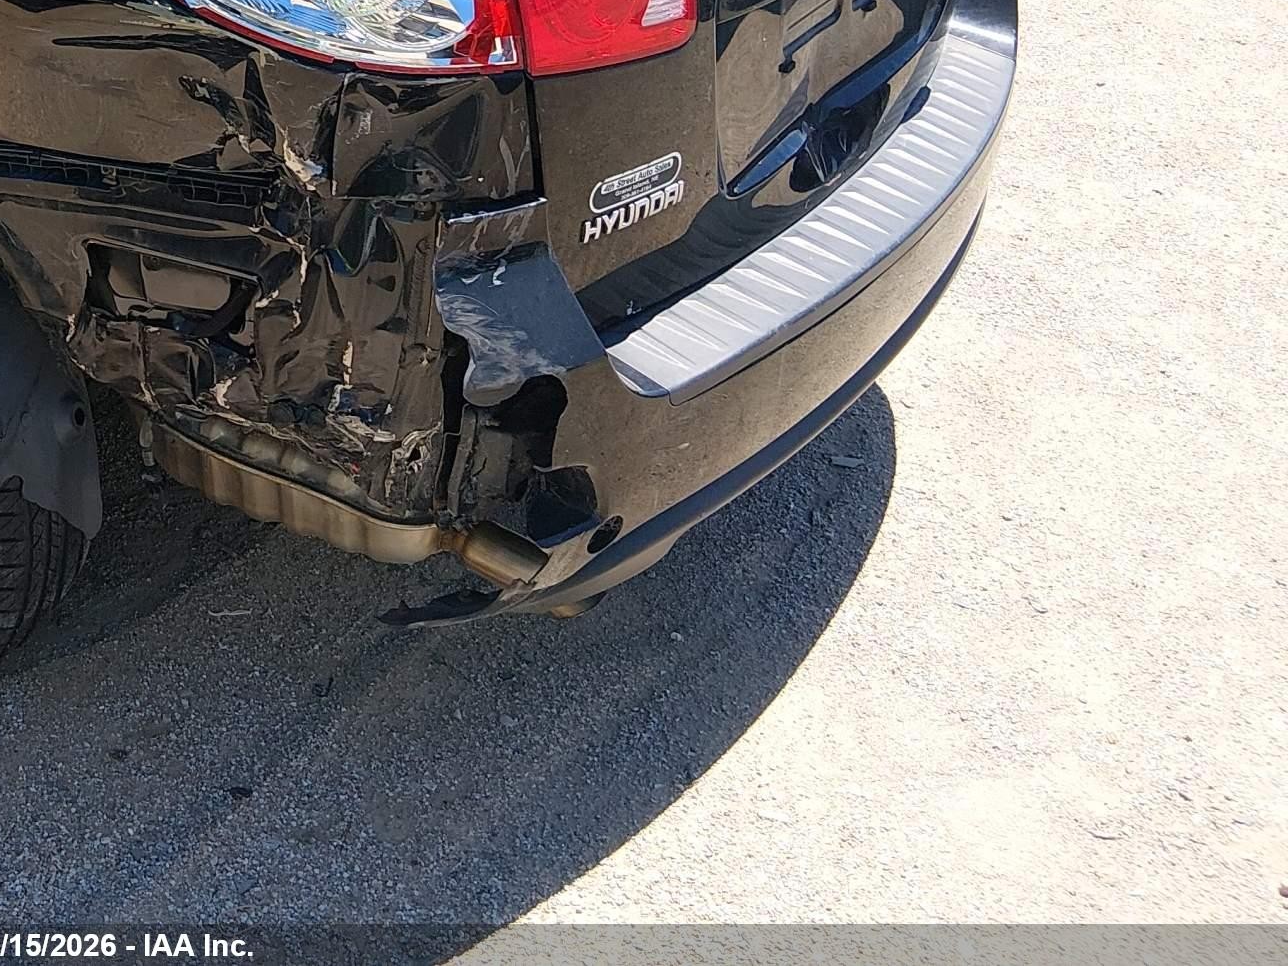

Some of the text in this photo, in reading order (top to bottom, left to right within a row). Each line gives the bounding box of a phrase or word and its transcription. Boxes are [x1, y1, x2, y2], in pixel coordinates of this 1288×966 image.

[616, 174, 637, 188] Street
[638, 169, 653, 180] Auto
[654, 161, 671, 173] Sales
[583, 179, 685, 244] HYUNDAI
